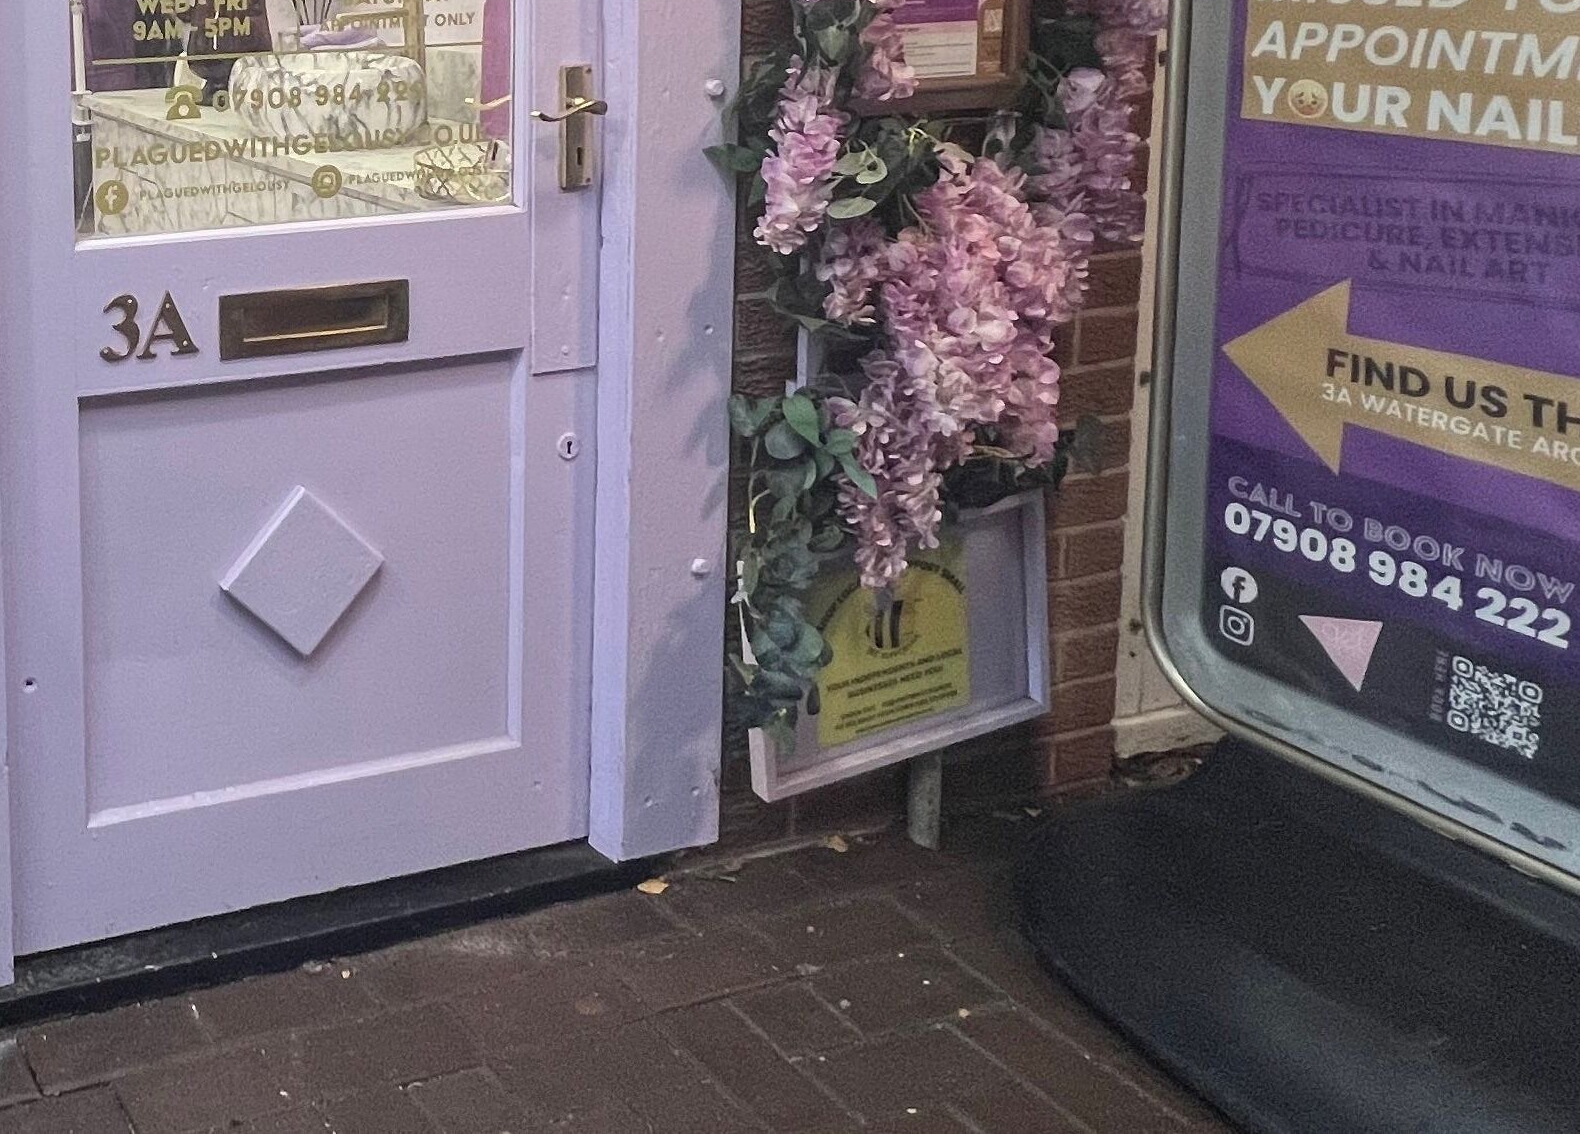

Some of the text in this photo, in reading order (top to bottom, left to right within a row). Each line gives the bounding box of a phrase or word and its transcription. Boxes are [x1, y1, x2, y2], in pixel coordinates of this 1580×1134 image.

[132, 18, 183, 41] 9AM
[204, 16, 251, 38] 5PM
[434, 12, 475, 26] ONLY
[1251, 20, 1580, 80] APPOINTM
[212, 86, 302, 112] 07908
[315, 82, 361, 106] 984
[1252, 75, 1578, 145] YUR NAIL
[1257, 192, 1421, 218] SPECIALIST
[1431, 199, 1465, 222] IN
[1367, 250, 1551, 285] & NAIL ART
[99, 290, 199, 363] 3A
[1326, 347, 1430, 397] FIND
[1444, 376, 1508, 418] US
[1321, 383, 1352, 406] 3A
[1361, 393, 1522, 450] WATERGATE
[1227, 475, 1575, 604] CALL TO BOOK NOW
[1224, 502, 1571, 650] 07908 984 222
